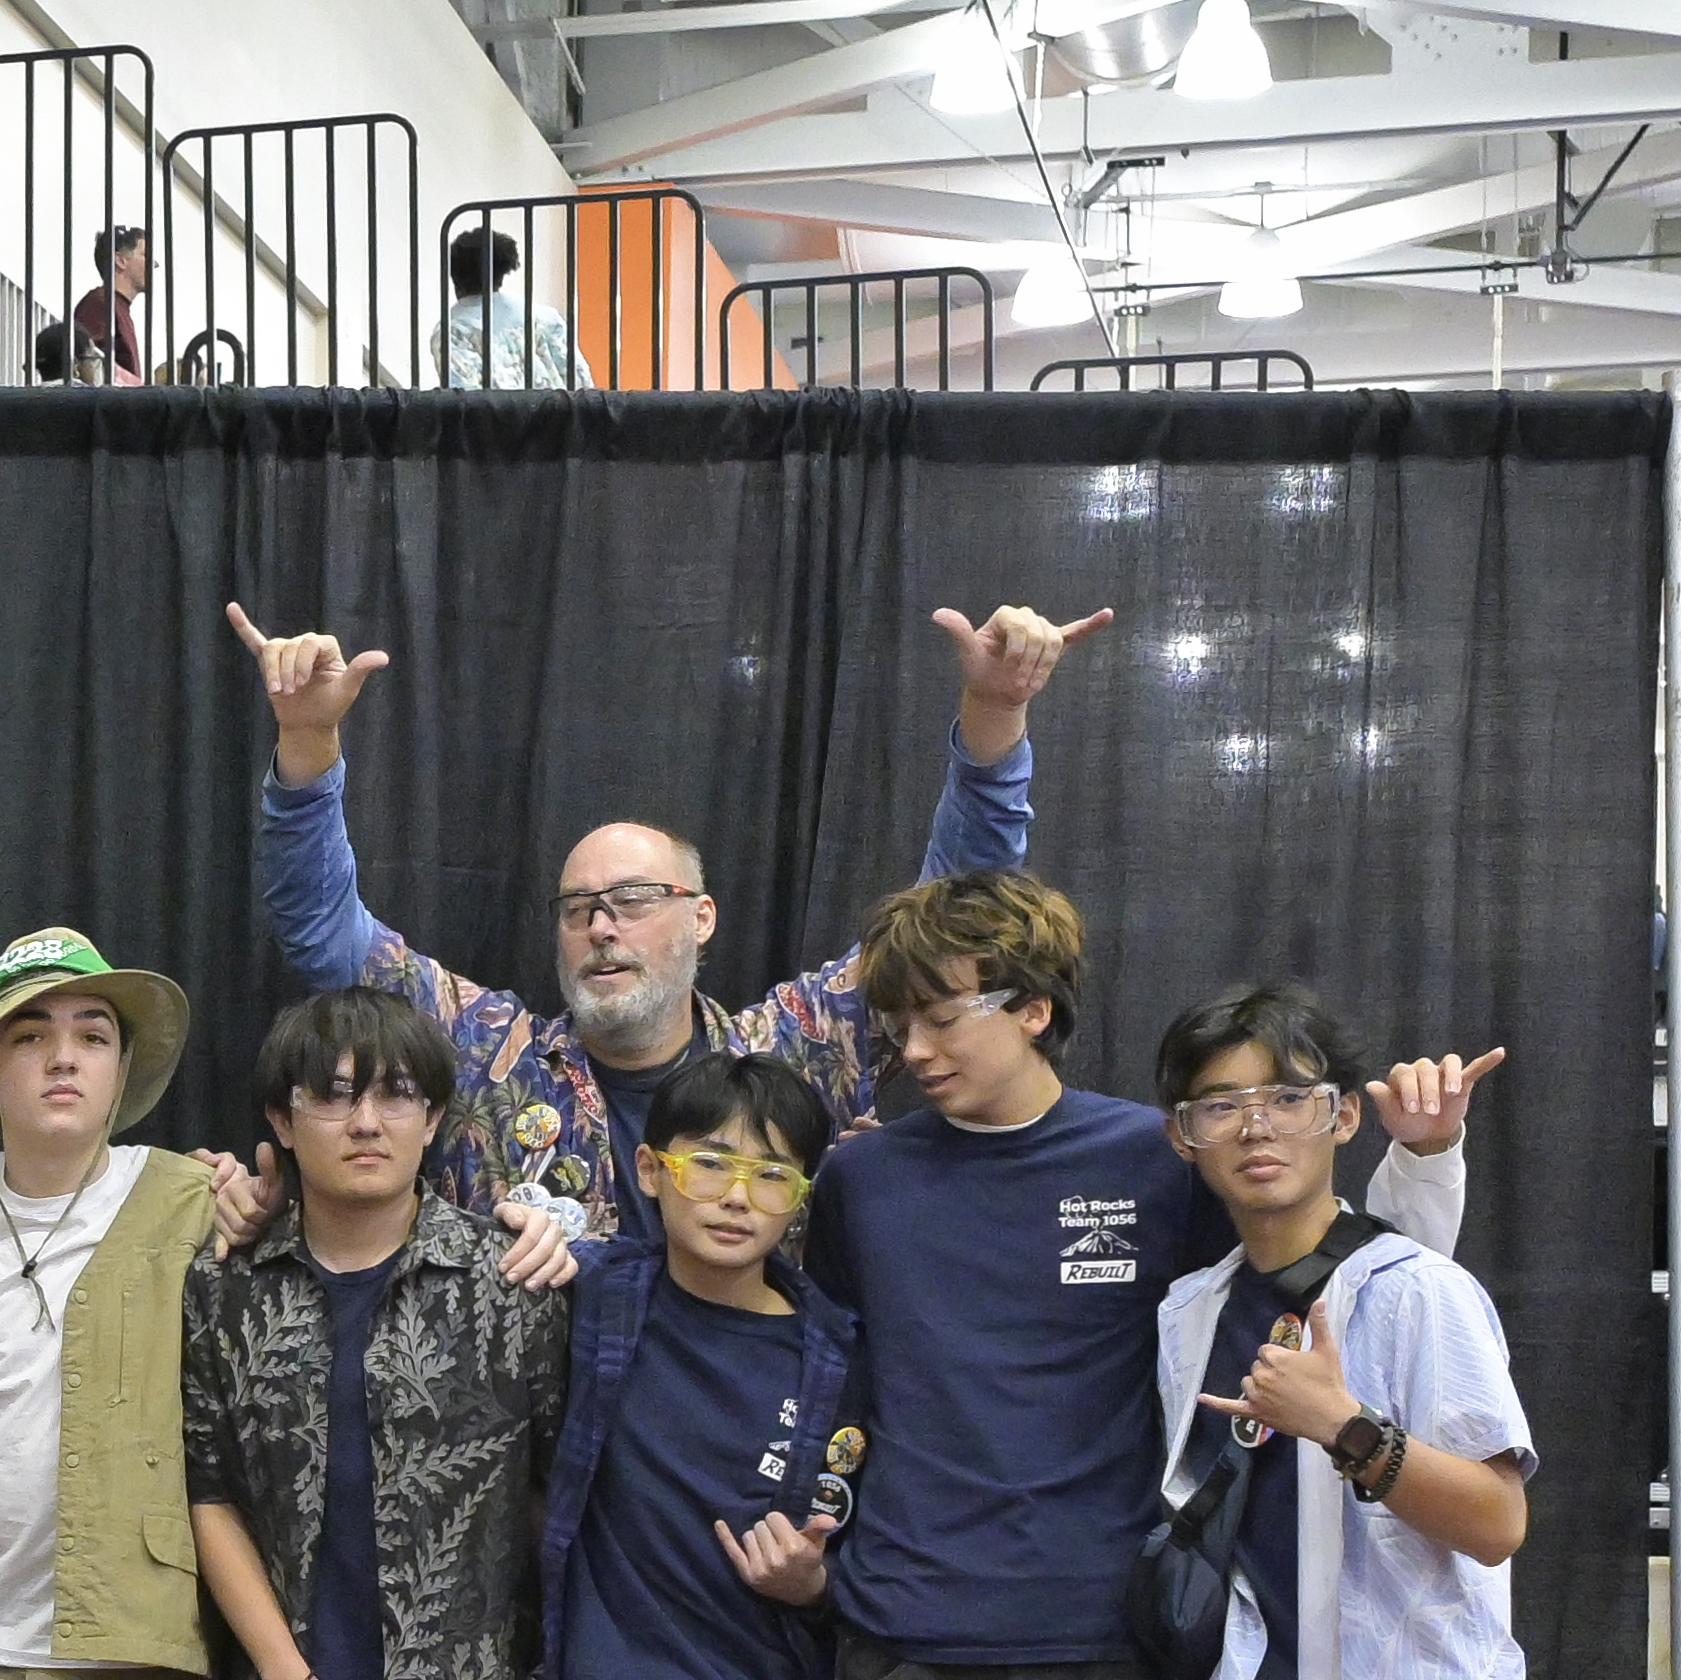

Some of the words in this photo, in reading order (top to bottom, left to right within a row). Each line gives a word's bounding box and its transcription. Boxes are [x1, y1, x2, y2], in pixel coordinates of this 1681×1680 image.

[1060, 1201, 1087, 1213] Hot
[1090, 1199, 1136, 1211] Rocks
[1058, 1216, 1100, 1228] Team
[1102, 1213, 1137, 1226] 1056
[1066, 1262, 1133, 1281] REBUILT
